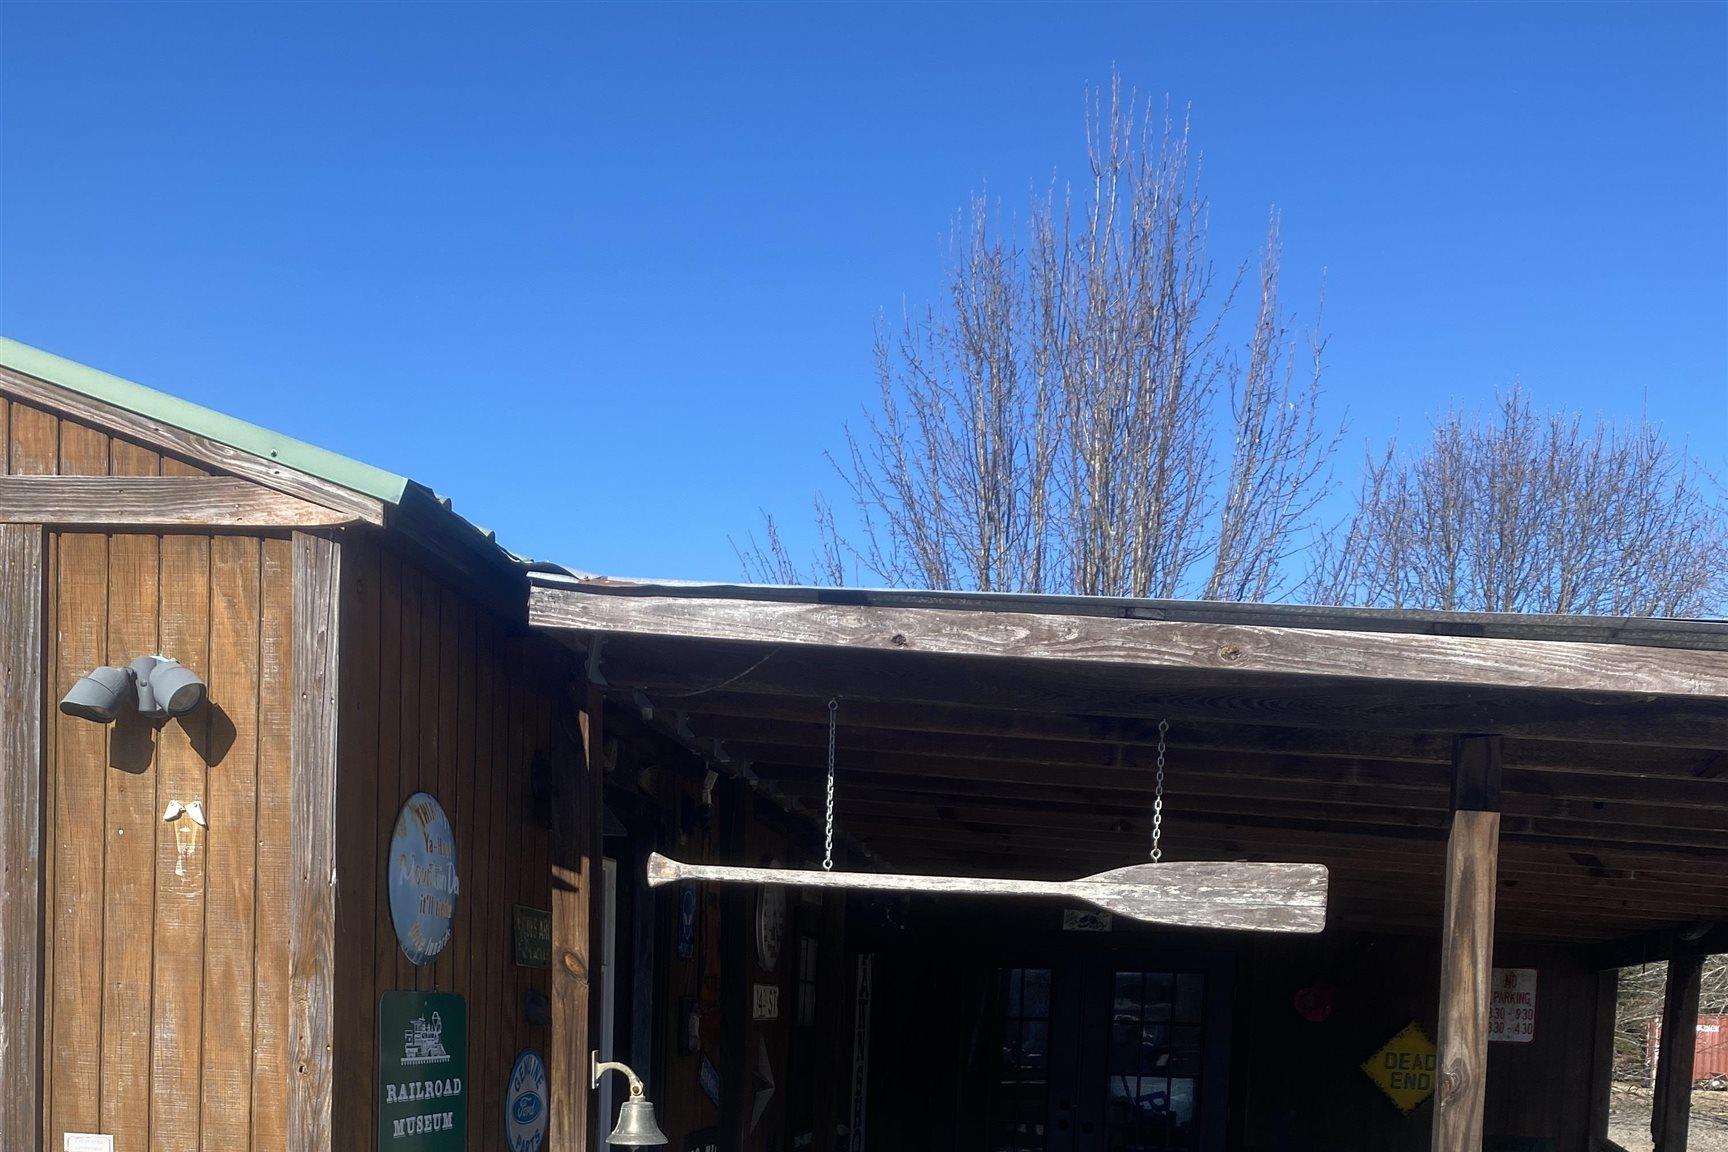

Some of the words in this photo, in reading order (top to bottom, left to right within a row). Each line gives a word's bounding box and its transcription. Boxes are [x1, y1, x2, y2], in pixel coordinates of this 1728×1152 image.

[1504, 973, 1517, 988] NO
[1493, 991, 1531, 1004] PARKING
[1384, 1052, 1436, 1071] DEAD
[514, 1056, 544, 1091] GENUINE
[1391, 1072, 1429, 1090] END
[386, 1078, 461, 1103] RAILROAD
[517, 1096, 536, 1117] Ford
[393, 1111, 453, 1138] MUSEUM
